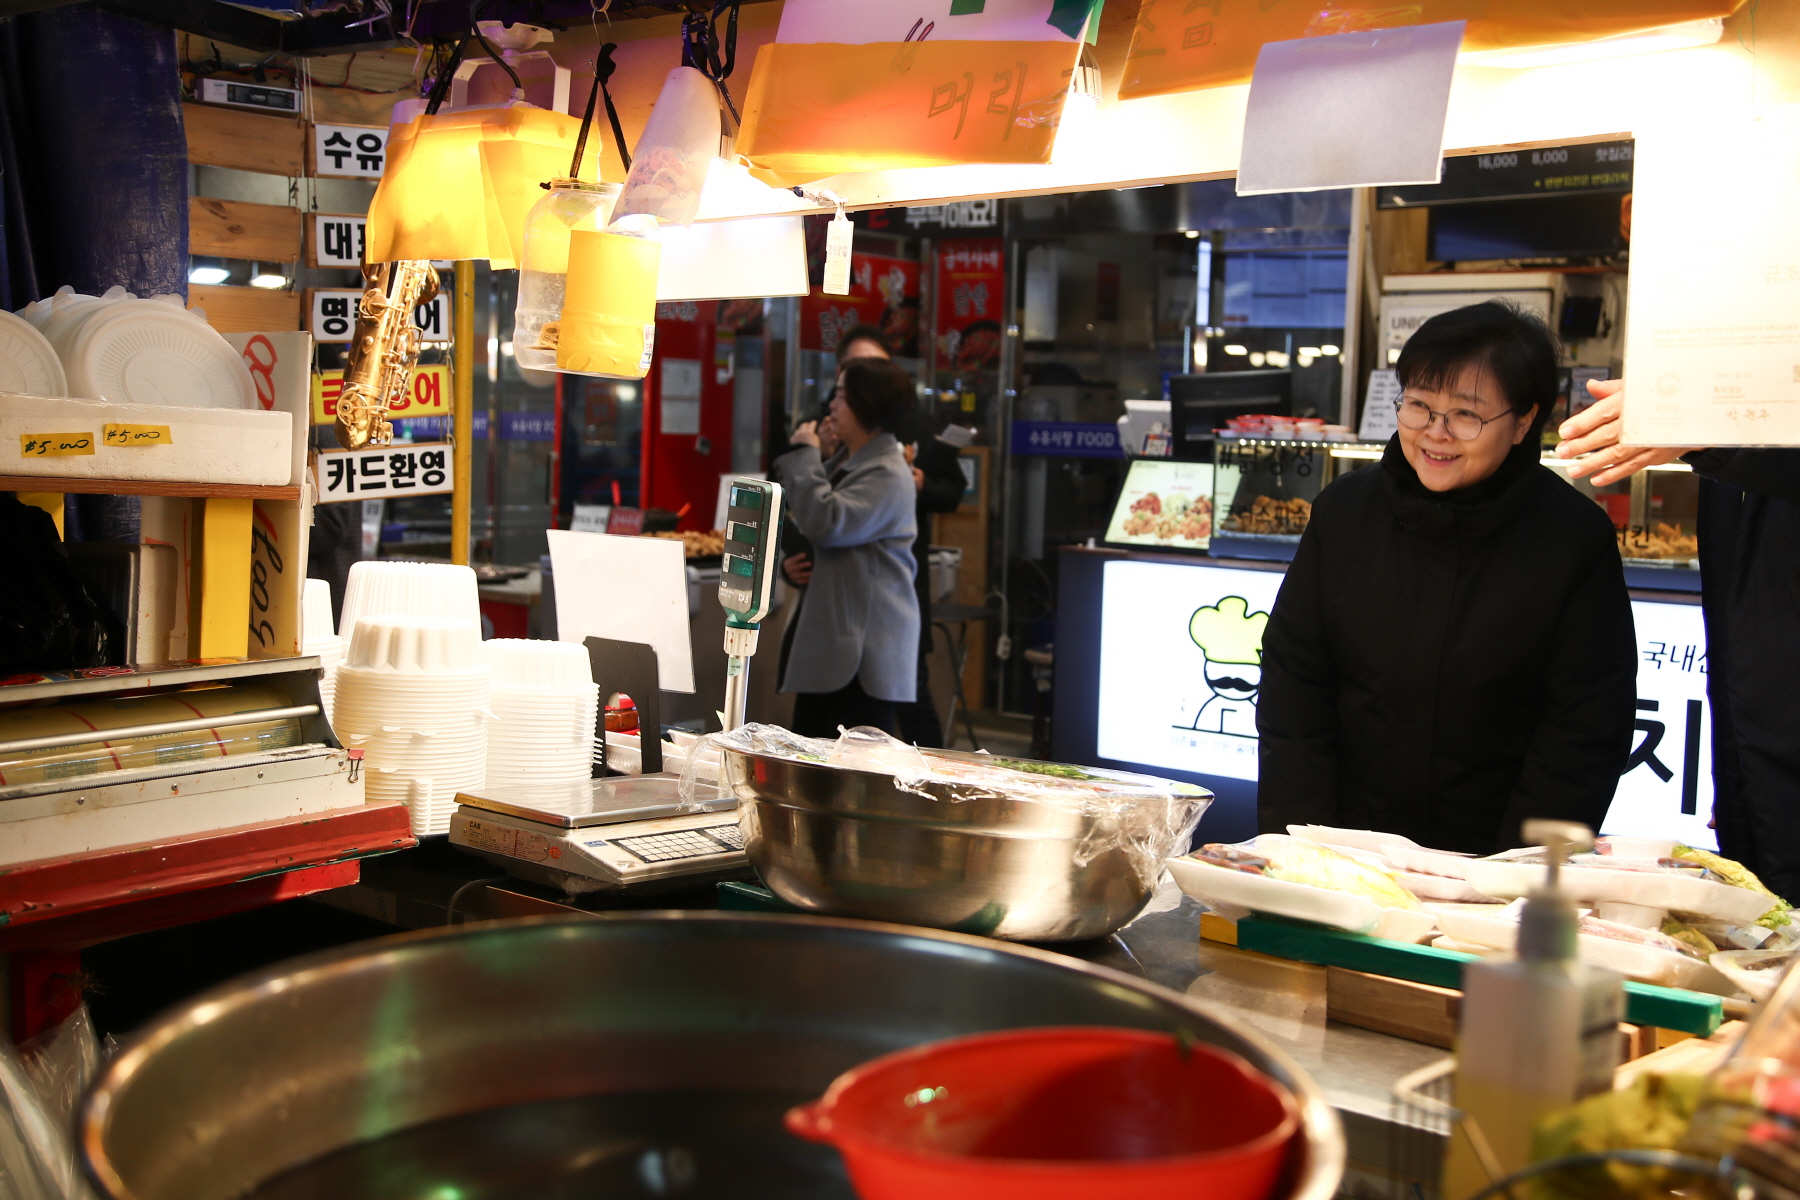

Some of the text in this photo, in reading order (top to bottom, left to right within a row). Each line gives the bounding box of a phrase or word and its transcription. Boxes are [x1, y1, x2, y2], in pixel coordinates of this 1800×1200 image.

[1077, 431, 1116, 448] FOOD
[326, 450, 446, 494] 카드환영
[469, 820, 481, 834] CAS
